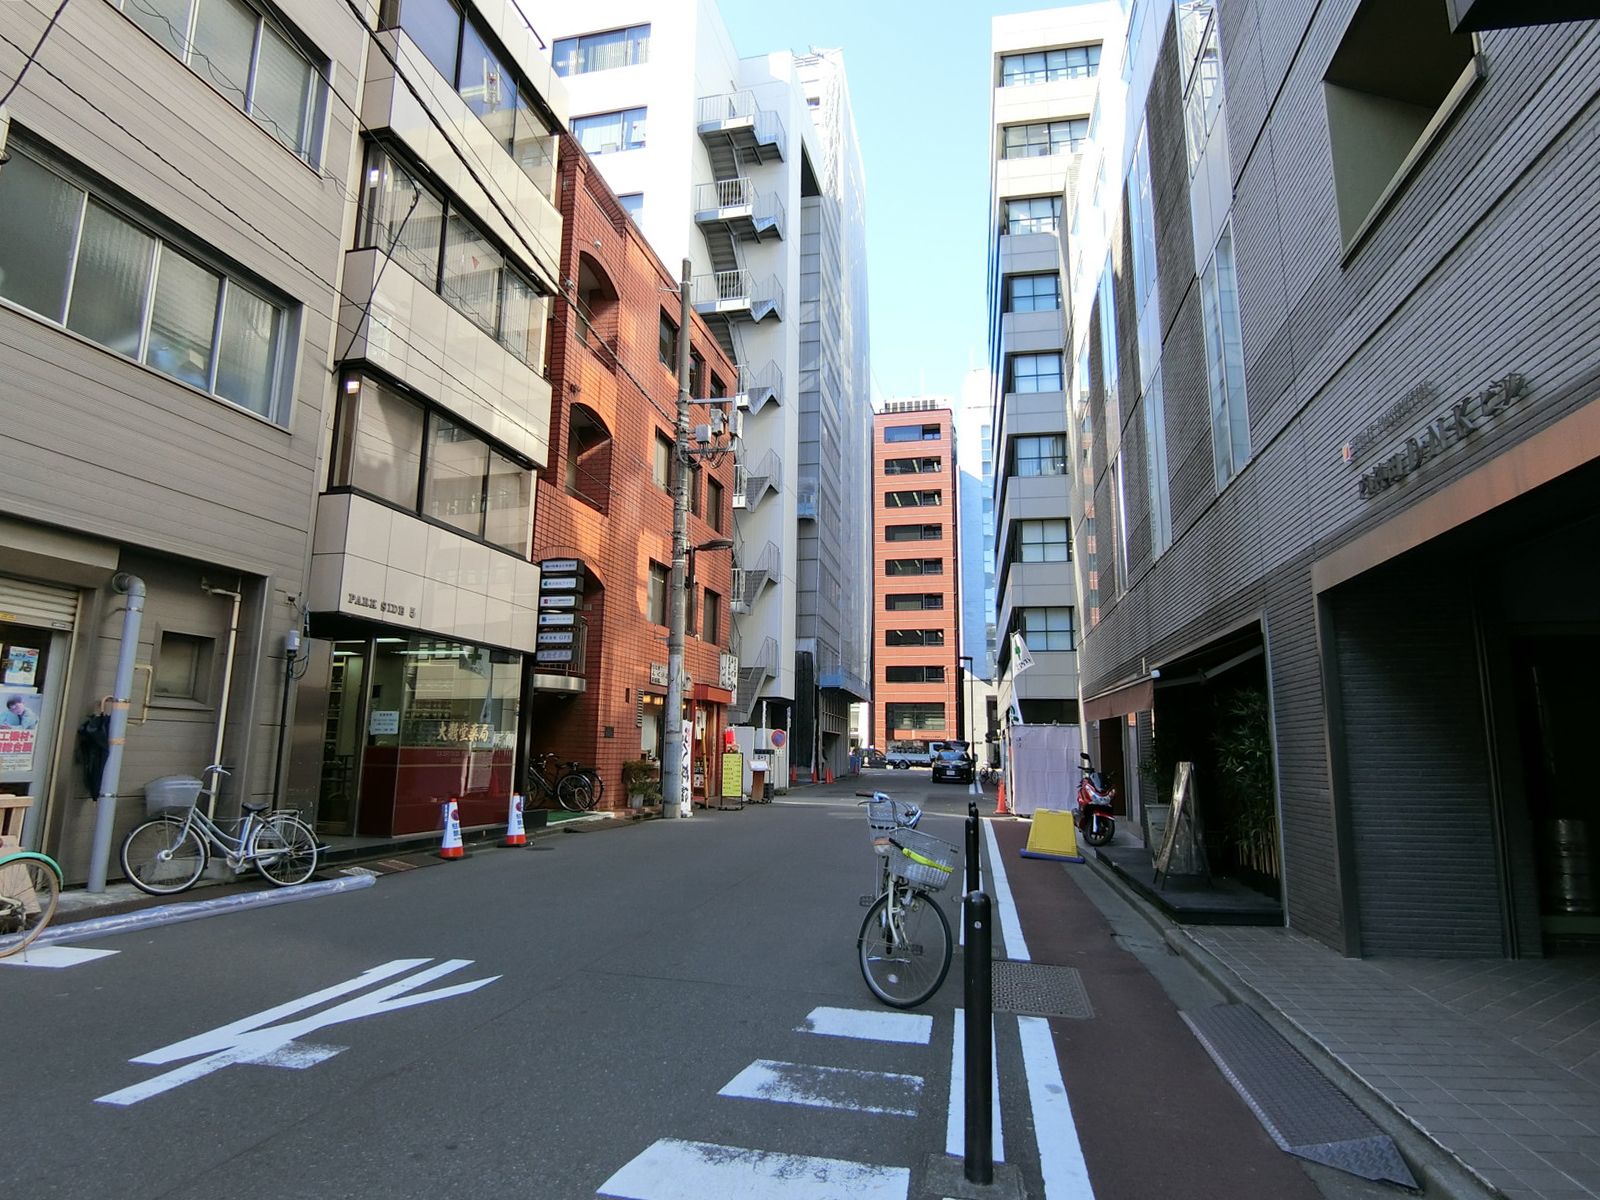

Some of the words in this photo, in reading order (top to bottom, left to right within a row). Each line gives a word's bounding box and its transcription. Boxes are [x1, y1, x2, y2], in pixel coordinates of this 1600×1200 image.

[347, 592, 377, 609] PARK
[380, 601, 404, 616] SIDE
[408, 606, 416, 618] 5
